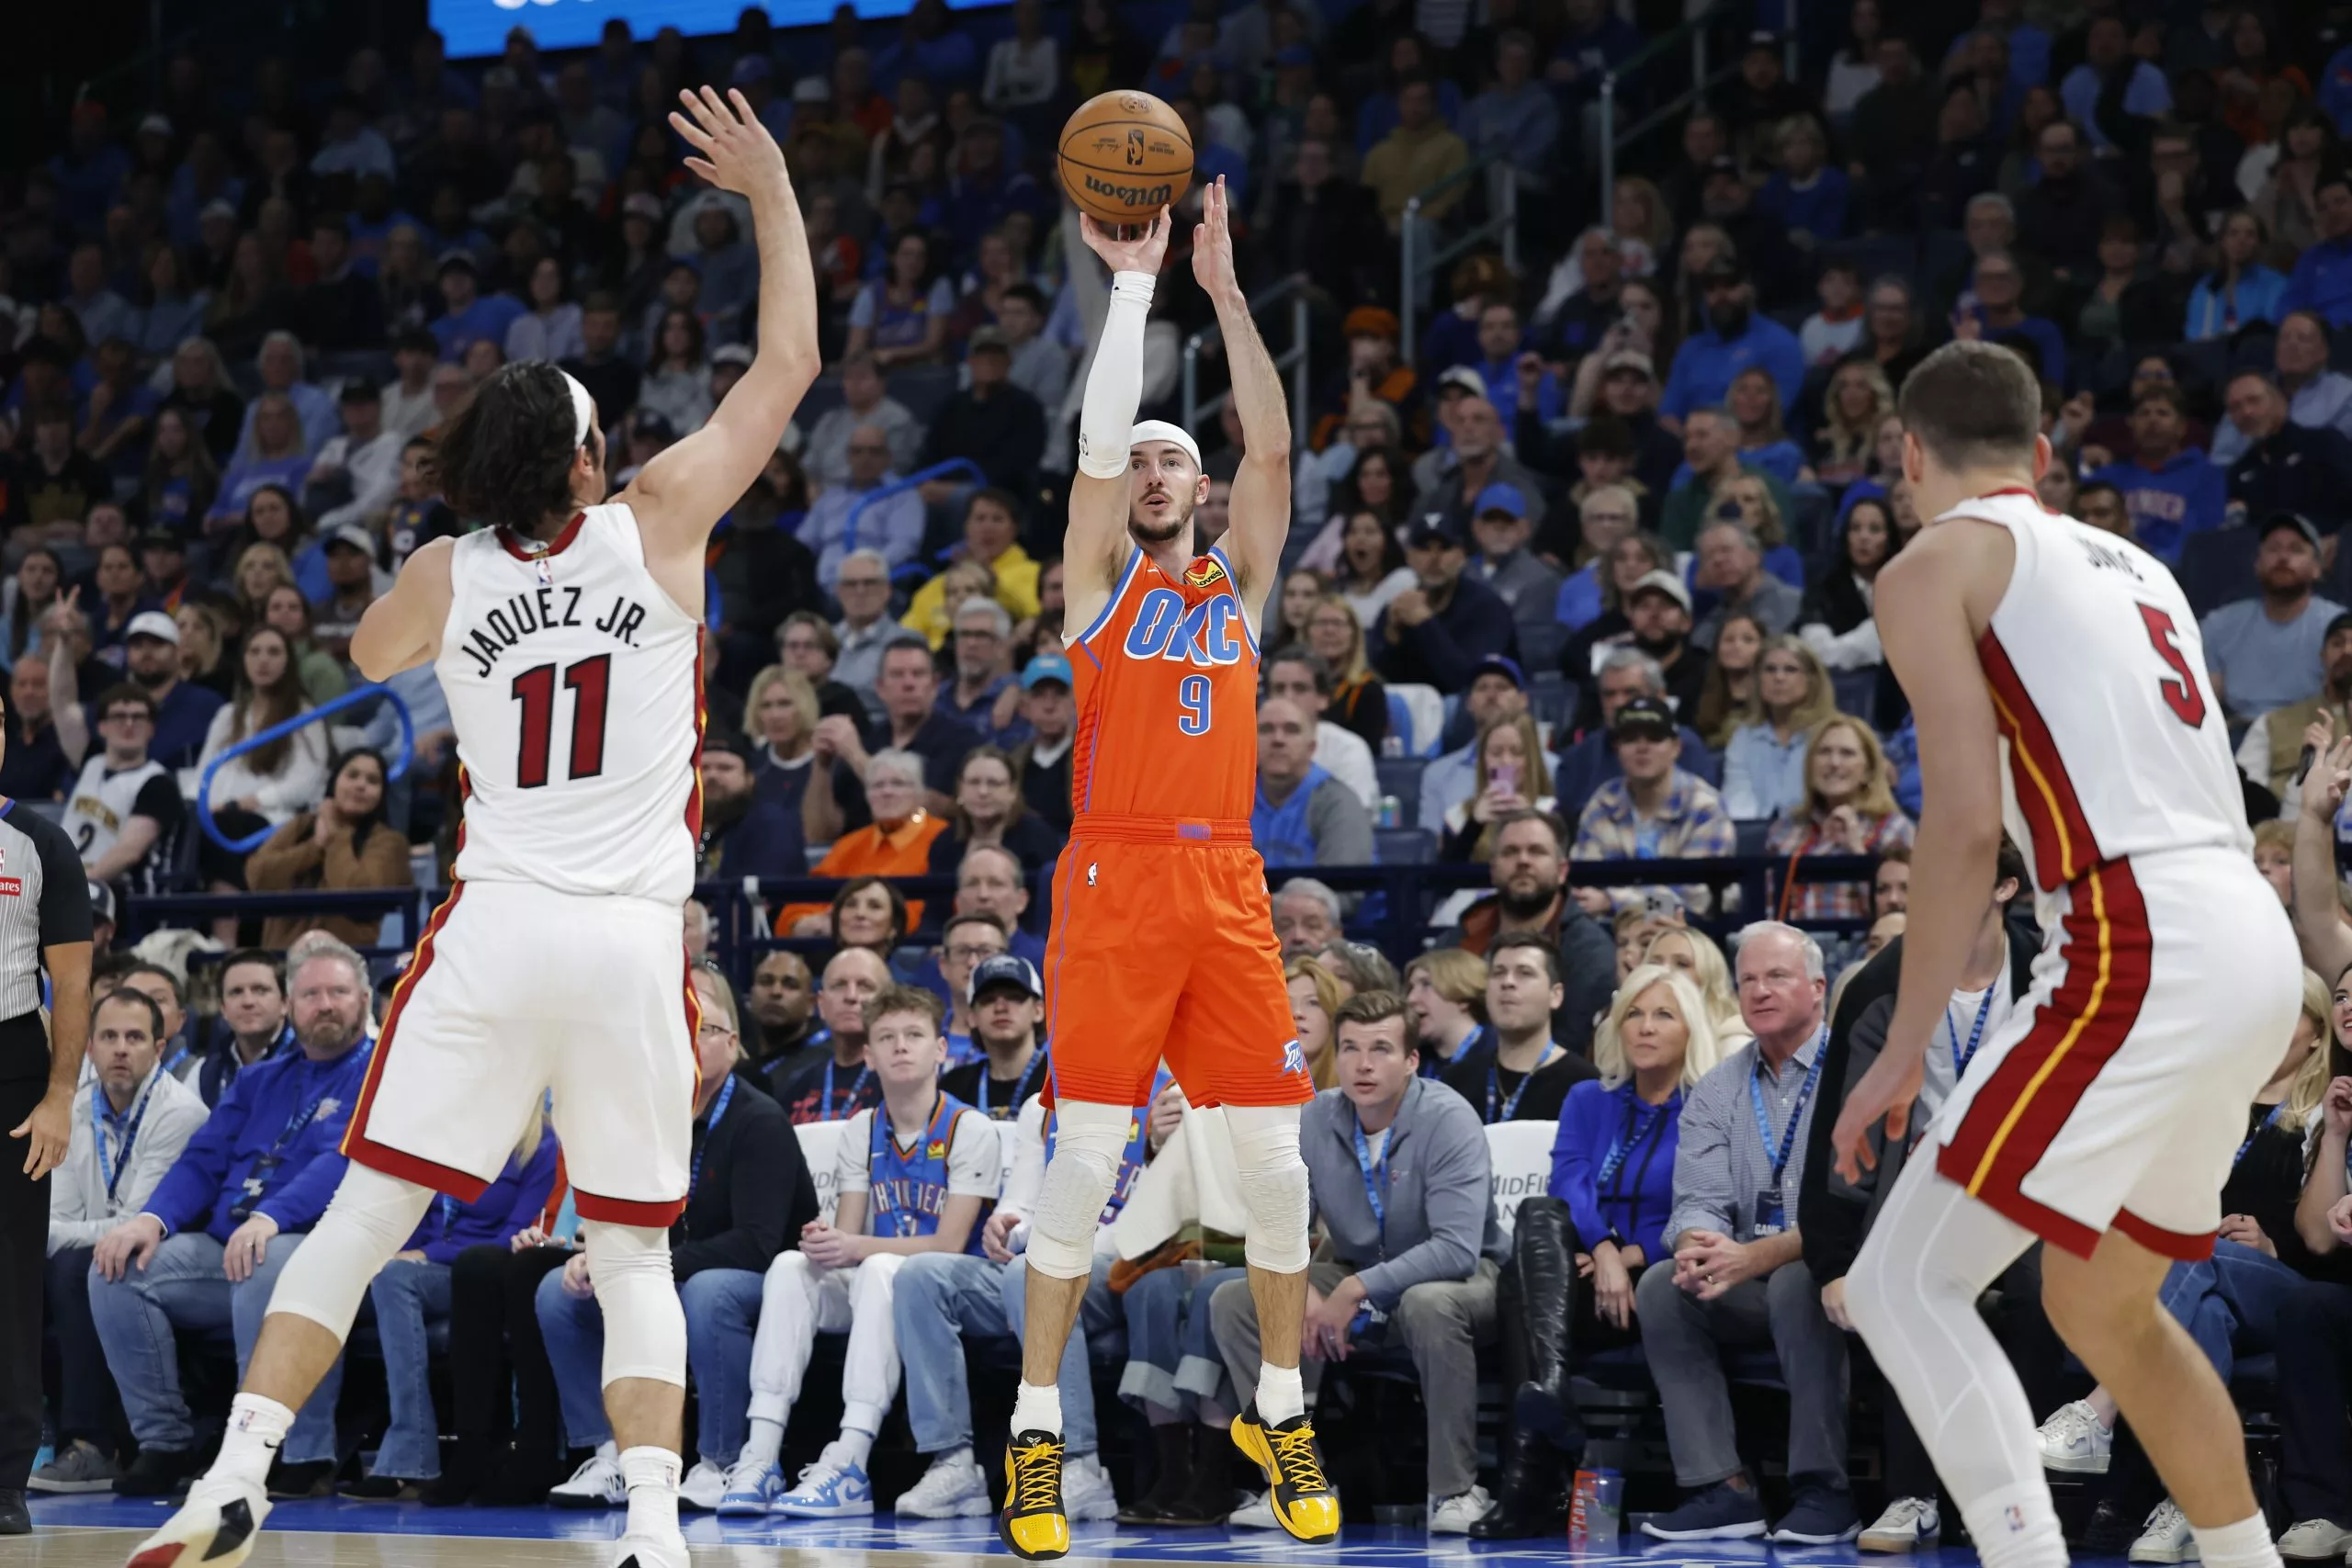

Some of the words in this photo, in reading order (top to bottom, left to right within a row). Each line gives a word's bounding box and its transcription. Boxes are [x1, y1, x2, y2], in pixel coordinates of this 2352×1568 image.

[1085, 174, 1172, 207] Wilson
[1193, 570, 1222, 586] Love's
[461, 587, 582, 679] JAQUEZ
[595, 596, 646, 649] JR.
[1123, 588, 1240, 667] OKC
[2133, 599, 2207, 730] 5
[511, 652, 612, 789] 11
[1179, 674, 1213, 737] 9
[0, 883, 20, 892] ates
